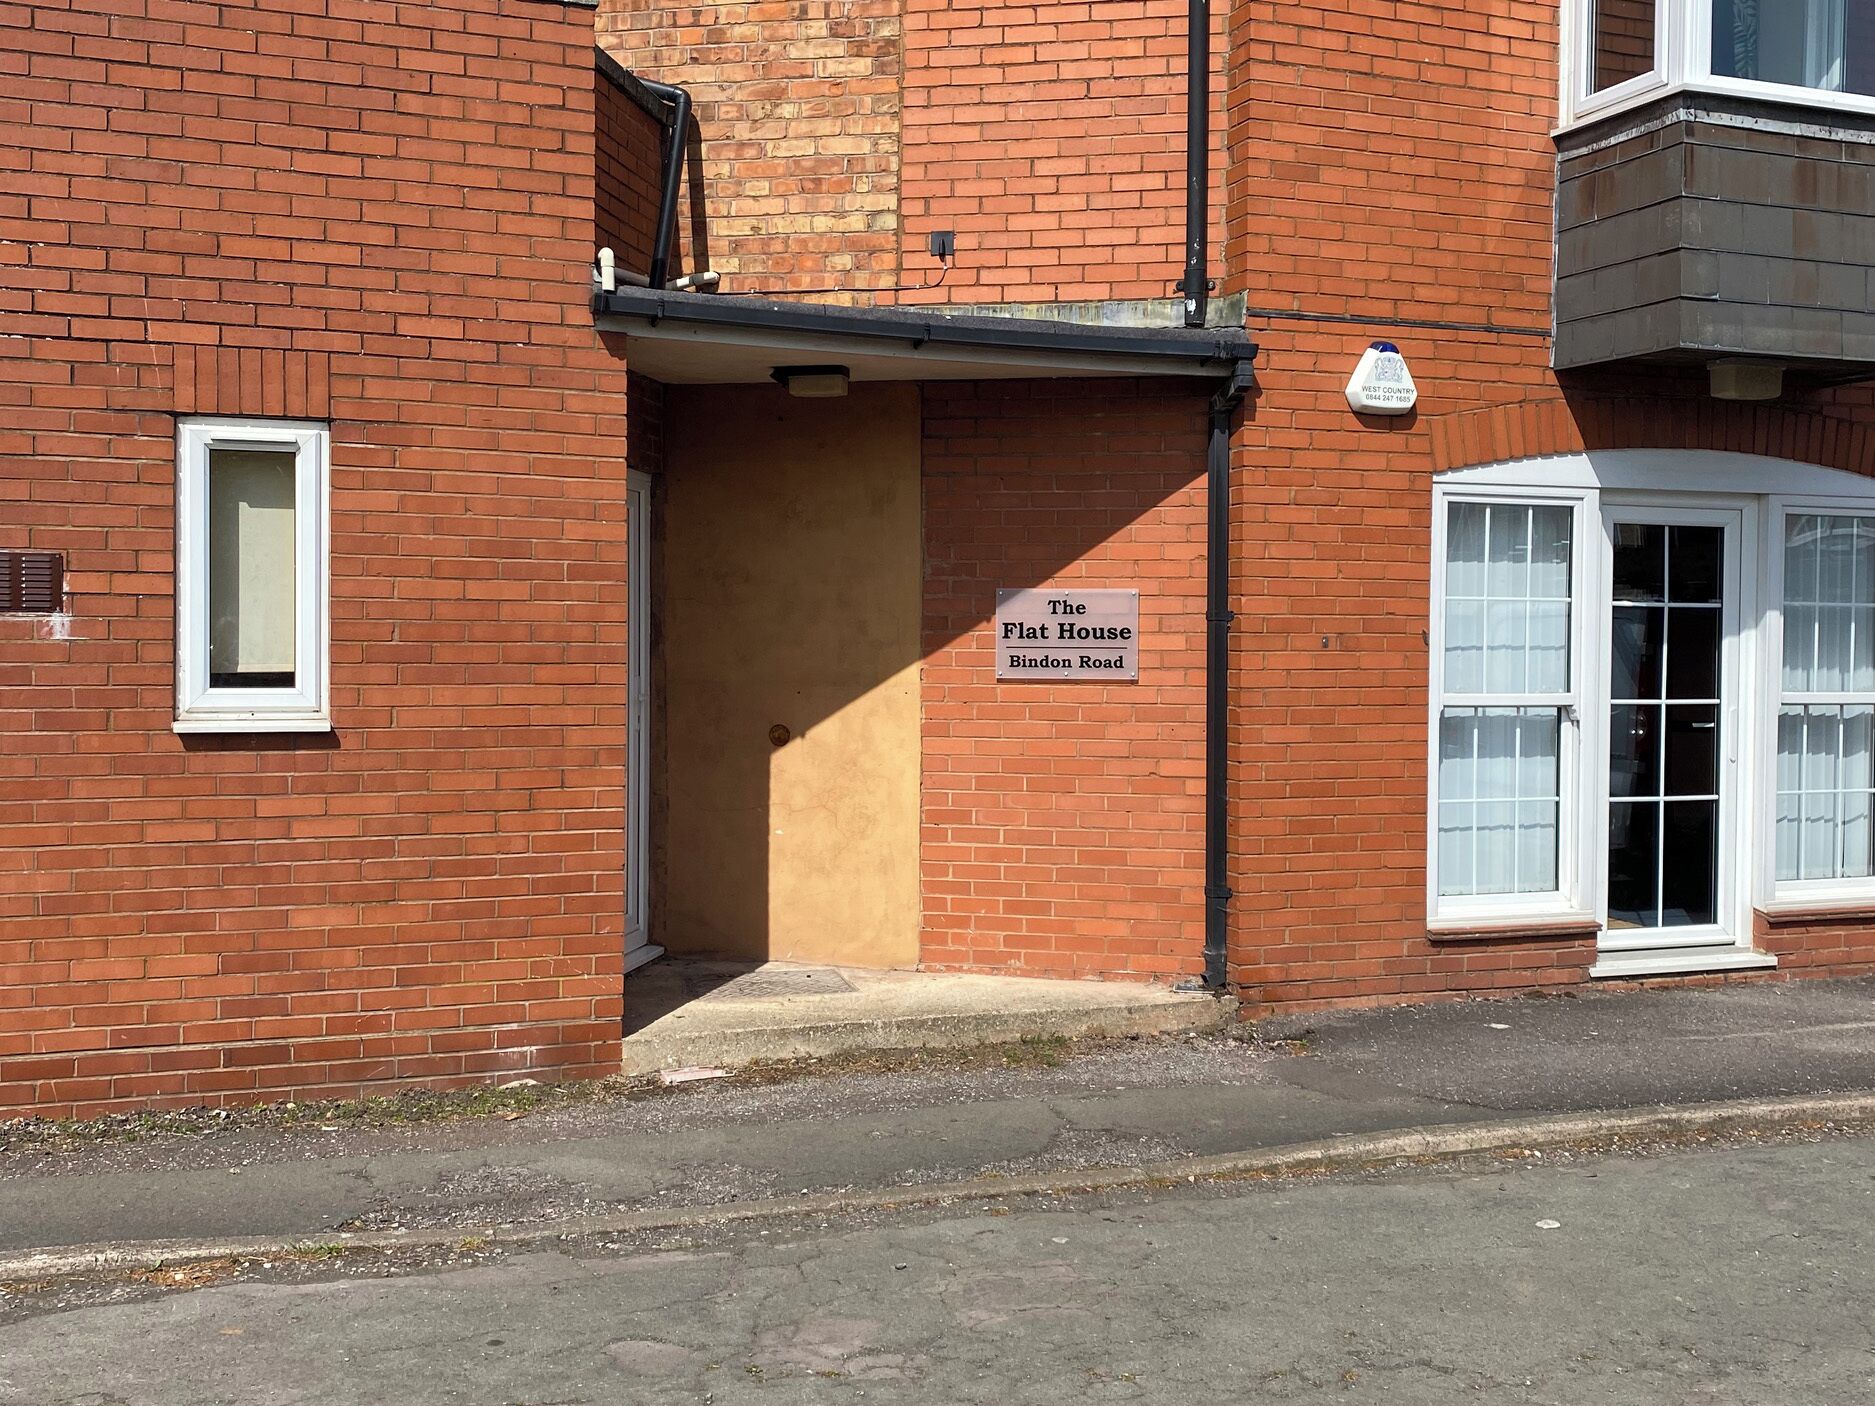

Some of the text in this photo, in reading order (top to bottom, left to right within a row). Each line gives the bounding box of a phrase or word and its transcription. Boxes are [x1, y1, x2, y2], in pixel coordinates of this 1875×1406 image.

[1361, 385, 1415, 395] WEST COUNTRY
[1365, 393, 1381, 401] 0844
[1047, 599, 1087, 615] The
[1002, 621, 1132, 640] Flat House
[1008, 654, 1125, 669] Bindon Road
